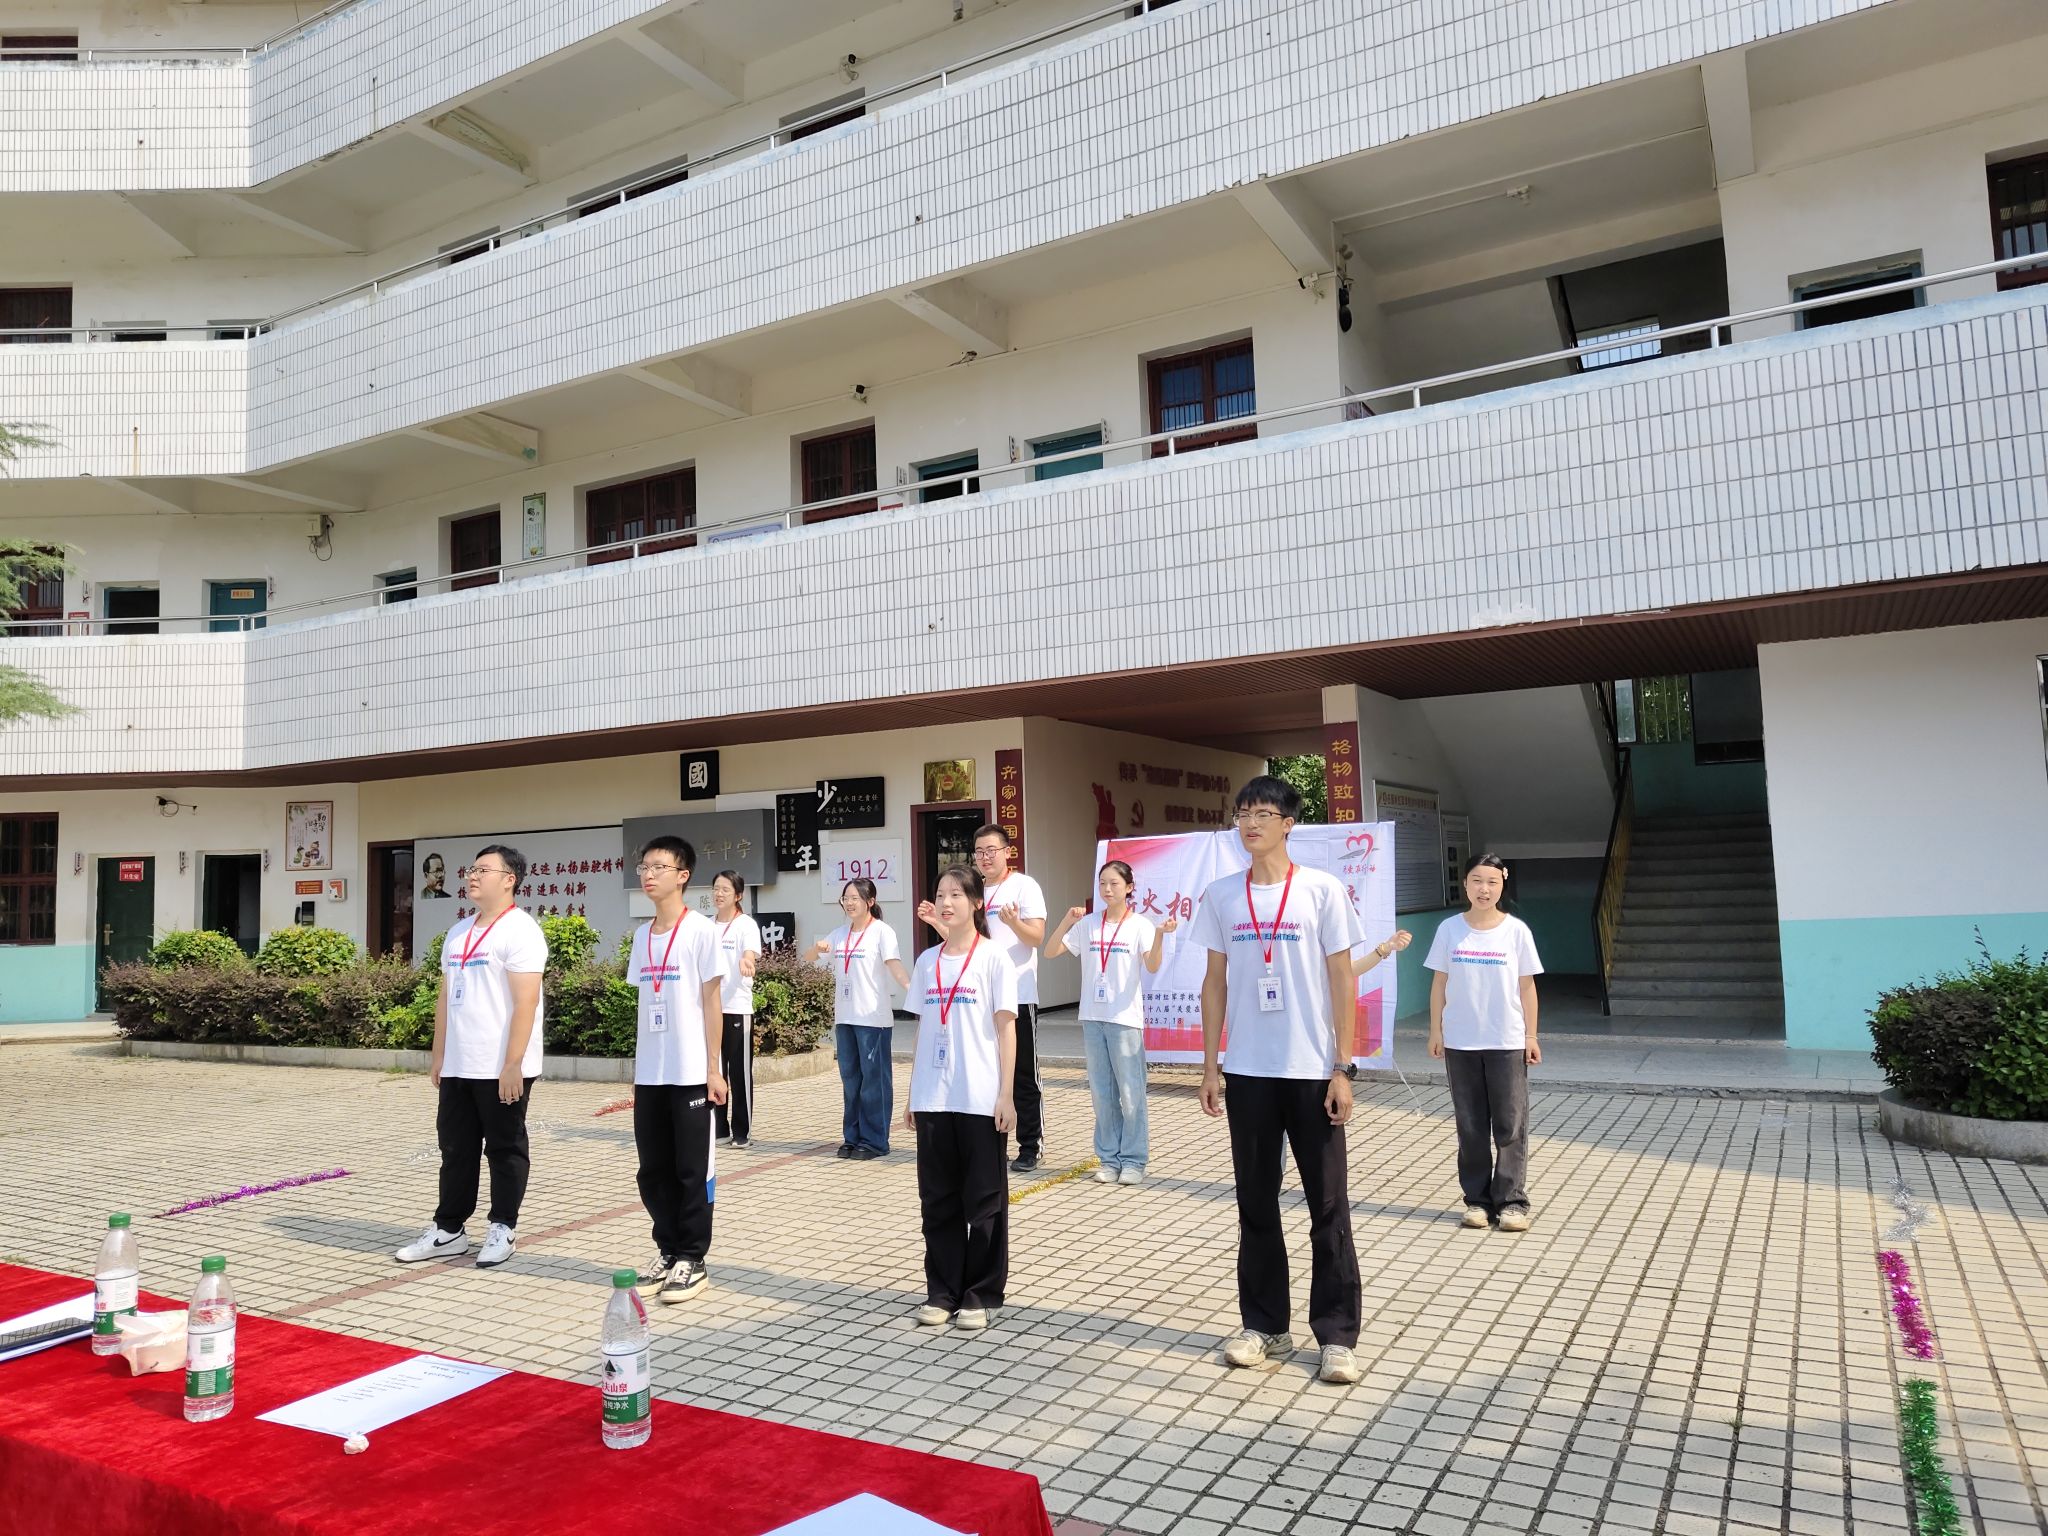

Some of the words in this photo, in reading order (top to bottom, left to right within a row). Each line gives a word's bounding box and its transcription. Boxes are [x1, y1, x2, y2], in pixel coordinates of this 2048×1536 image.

[688, 761, 708, 789] 國
[1332, 739, 1355, 822] 格物致知
[816, 781, 838, 813] 少
[795, 845, 818, 877] 年
[838, 859, 889, 881] 1912
[761, 921, 785, 953] 中
[1268, 921, 1300, 930] ATION
[689, 1098, 706, 1106] XTEP
[602, 1382, 628, 1393] 夫山泉
